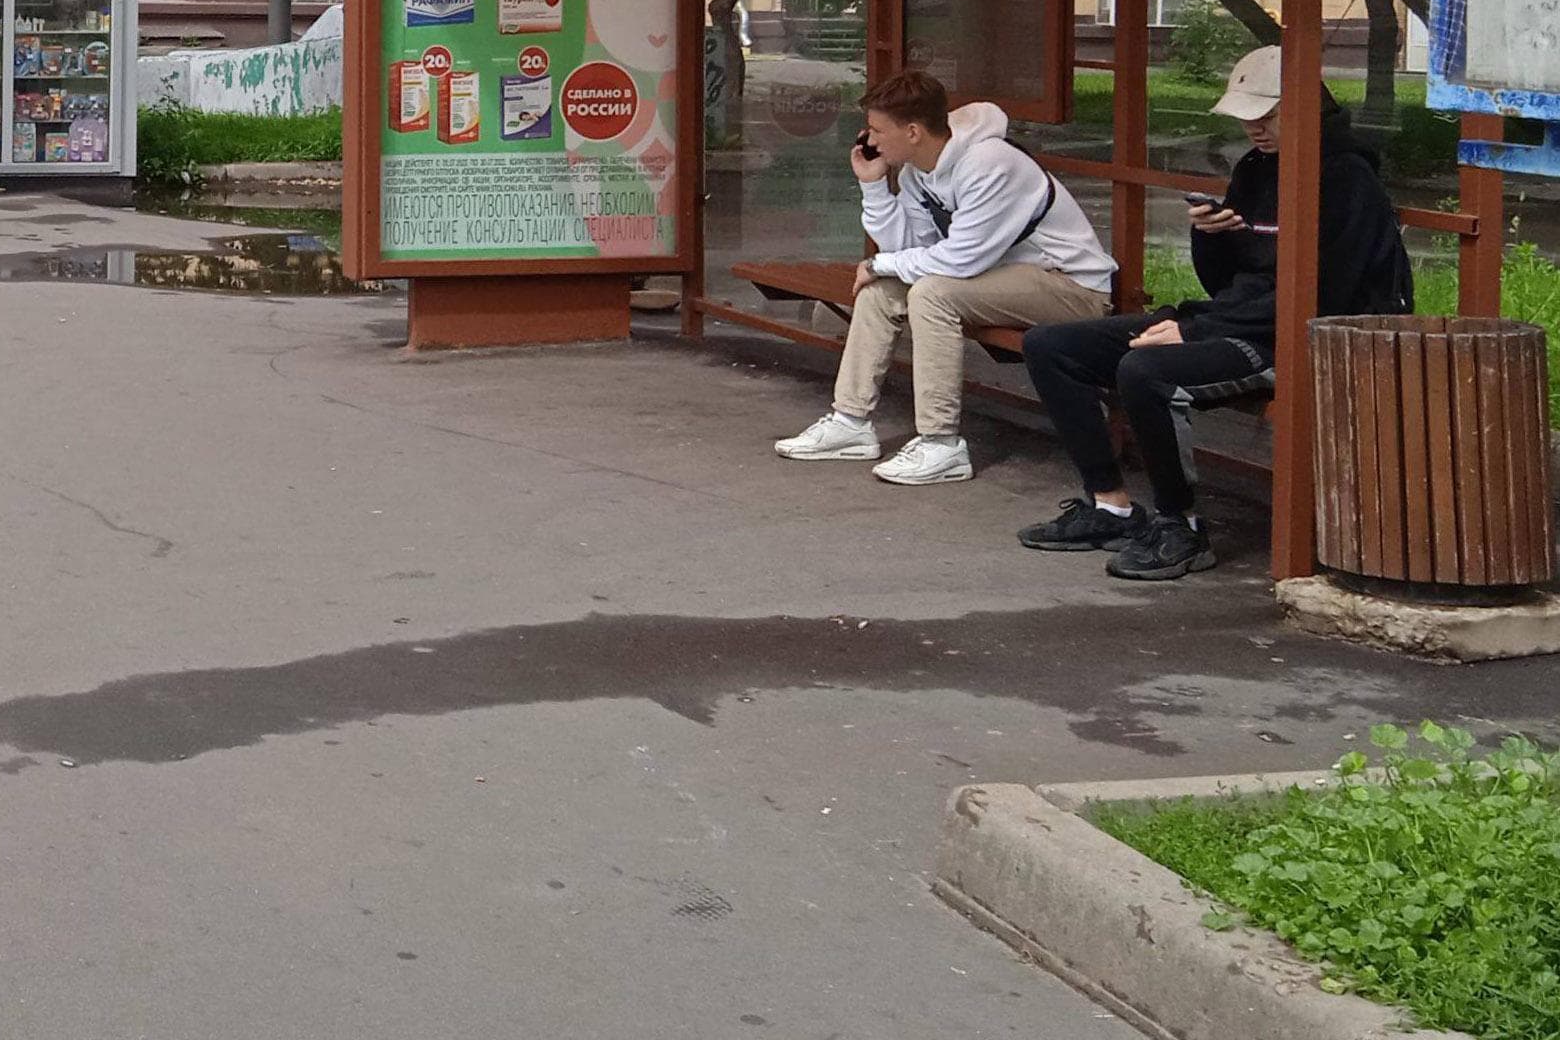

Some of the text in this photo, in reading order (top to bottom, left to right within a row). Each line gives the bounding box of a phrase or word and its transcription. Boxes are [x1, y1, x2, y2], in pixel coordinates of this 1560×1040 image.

[567, 89, 632, 100] СДЕЛАНО В
[567, 103, 632, 116] РОССИИ
[384, 194, 443, 219] ИМЕЮТСЯ
[581, 192, 663, 217] НЕОБХОДИМО
[384, 215, 664, 245] ПОЛУЧЕНИЕ КОНСУЛЬТАЦИИ СПЕЦИАЛИСТА
